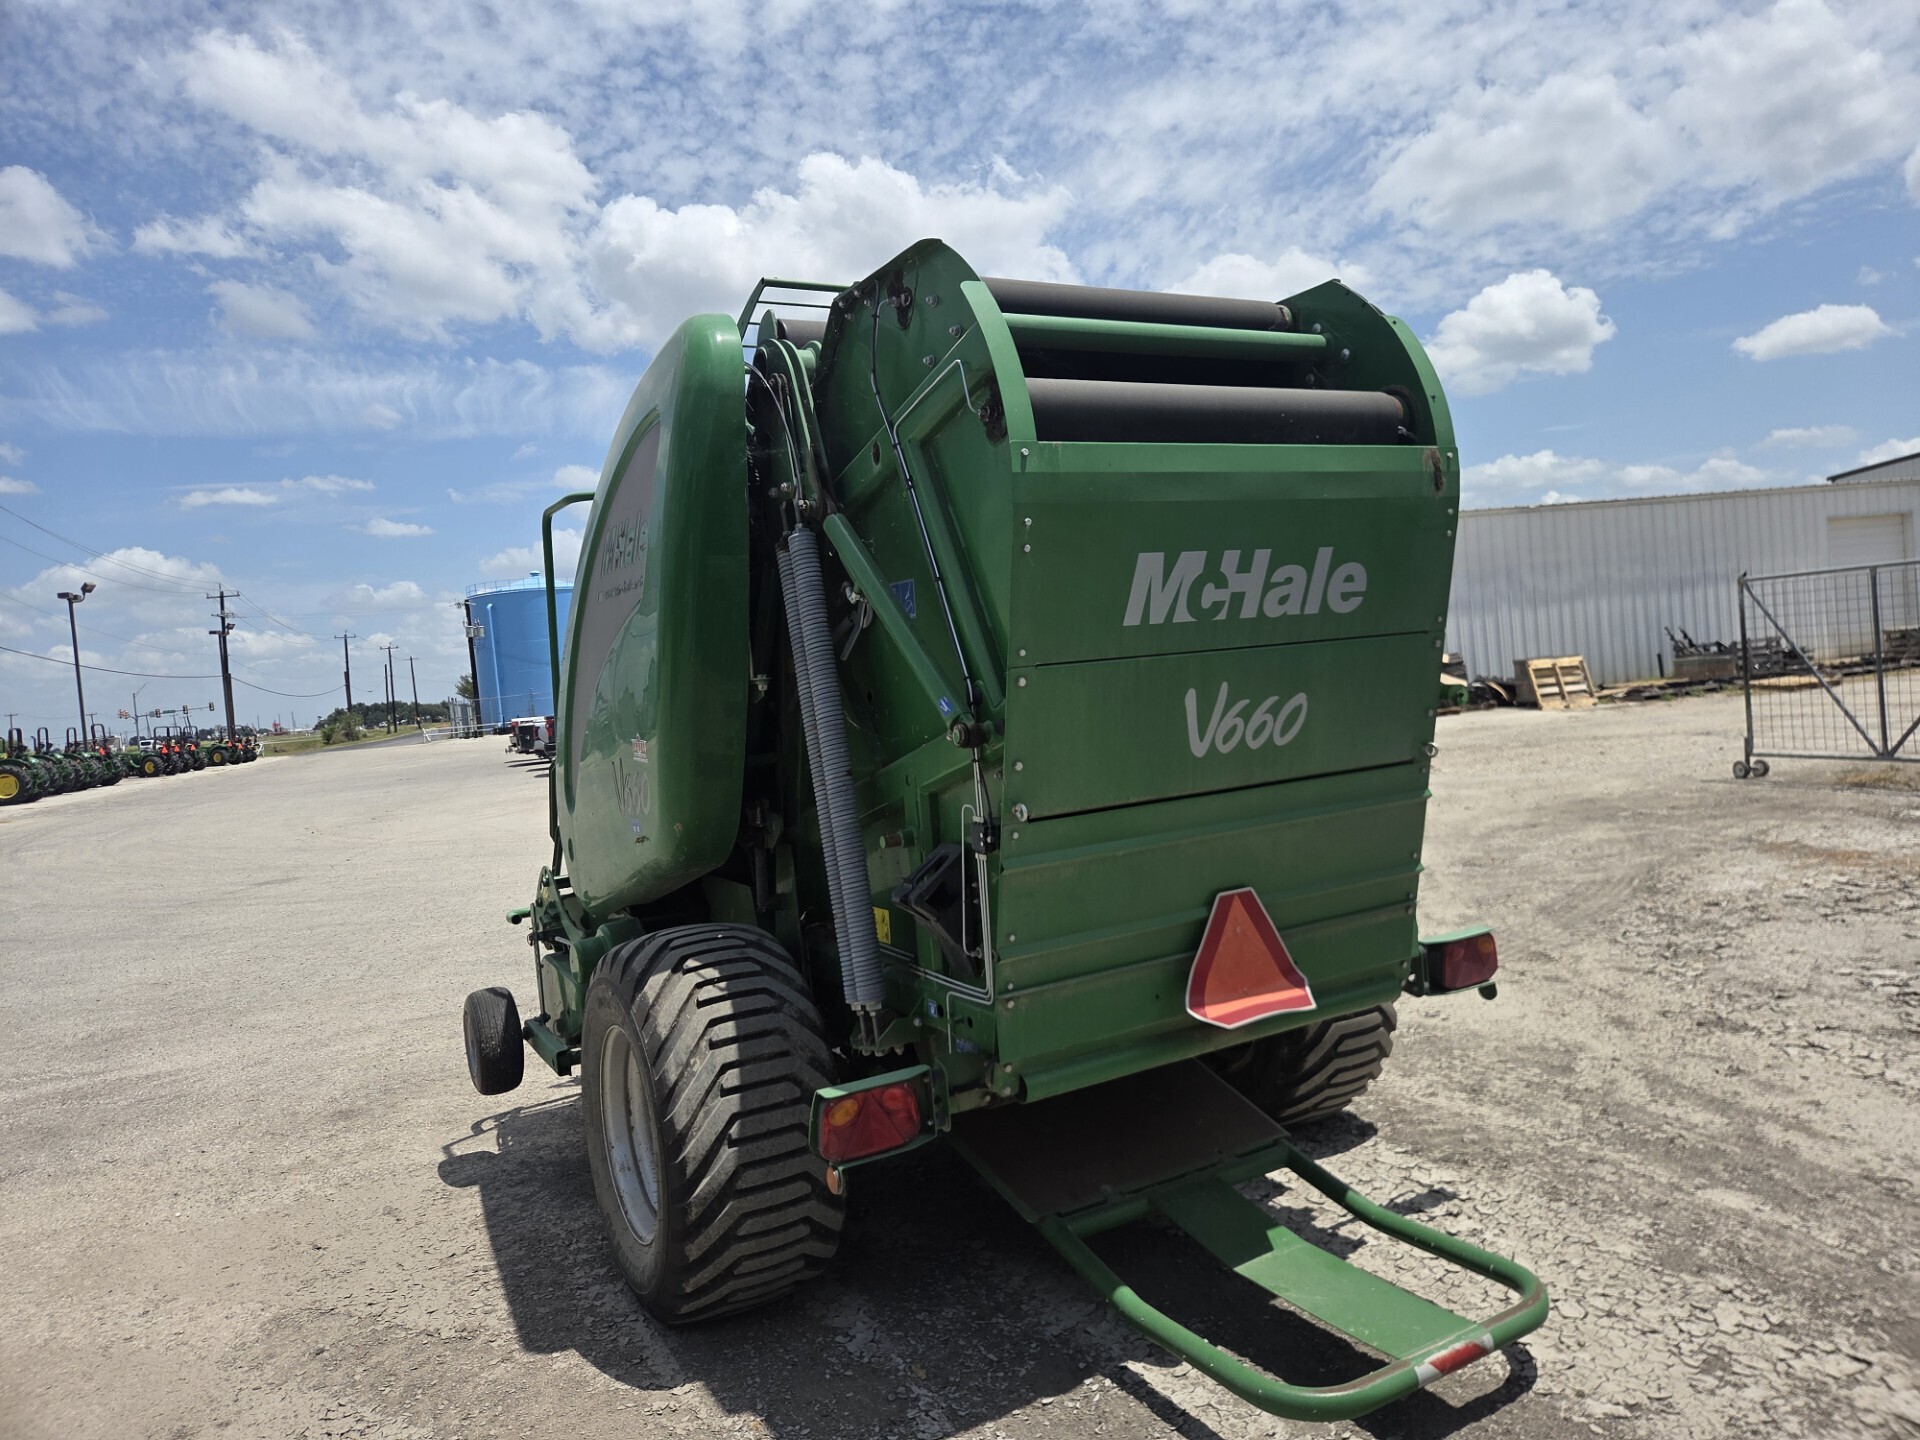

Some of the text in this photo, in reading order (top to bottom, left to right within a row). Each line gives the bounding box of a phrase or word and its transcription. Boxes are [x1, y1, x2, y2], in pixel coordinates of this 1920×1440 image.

[1122, 547, 1367, 627] McHale
[1184, 681, 1308, 758] V660
[612, 757, 650, 816] V660
